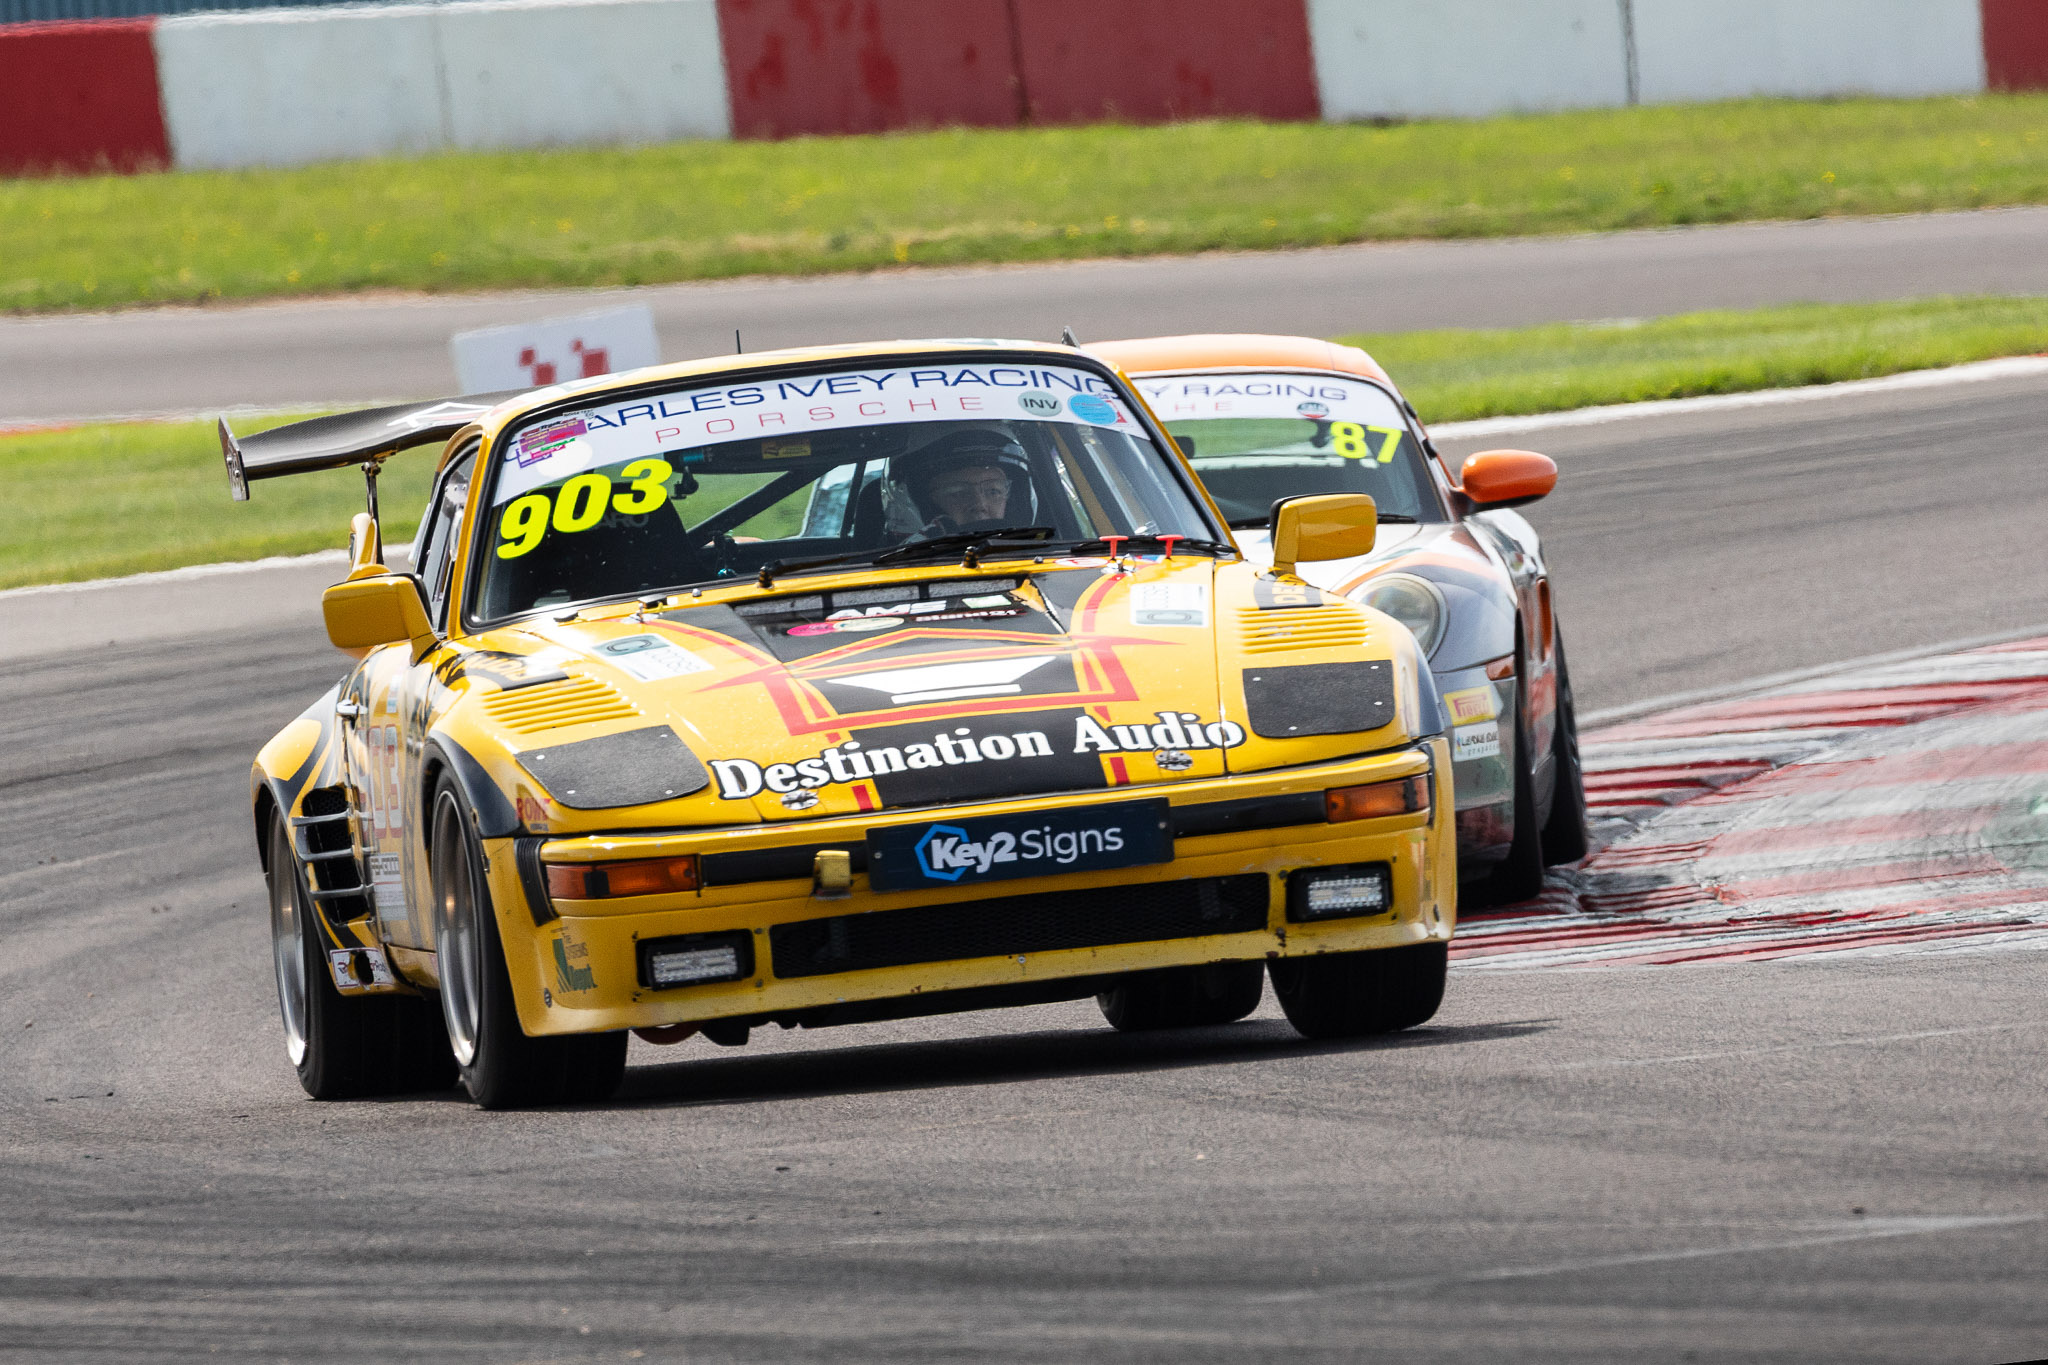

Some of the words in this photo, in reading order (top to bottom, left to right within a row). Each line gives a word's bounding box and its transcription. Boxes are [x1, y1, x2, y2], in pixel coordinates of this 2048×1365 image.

[778, 373, 897, 401] IVEY
[1023, 398, 1059, 410] INV
[1183, 383, 1348, 401] RACING
[655, 396, 984, 444] PORSCHE
[1331, 421, 1402, 463] 87
[497, 459, 672, 558] 903
[710, 727, 1055, 799] Destination
[1073, 711, 1244, 754] Audio
